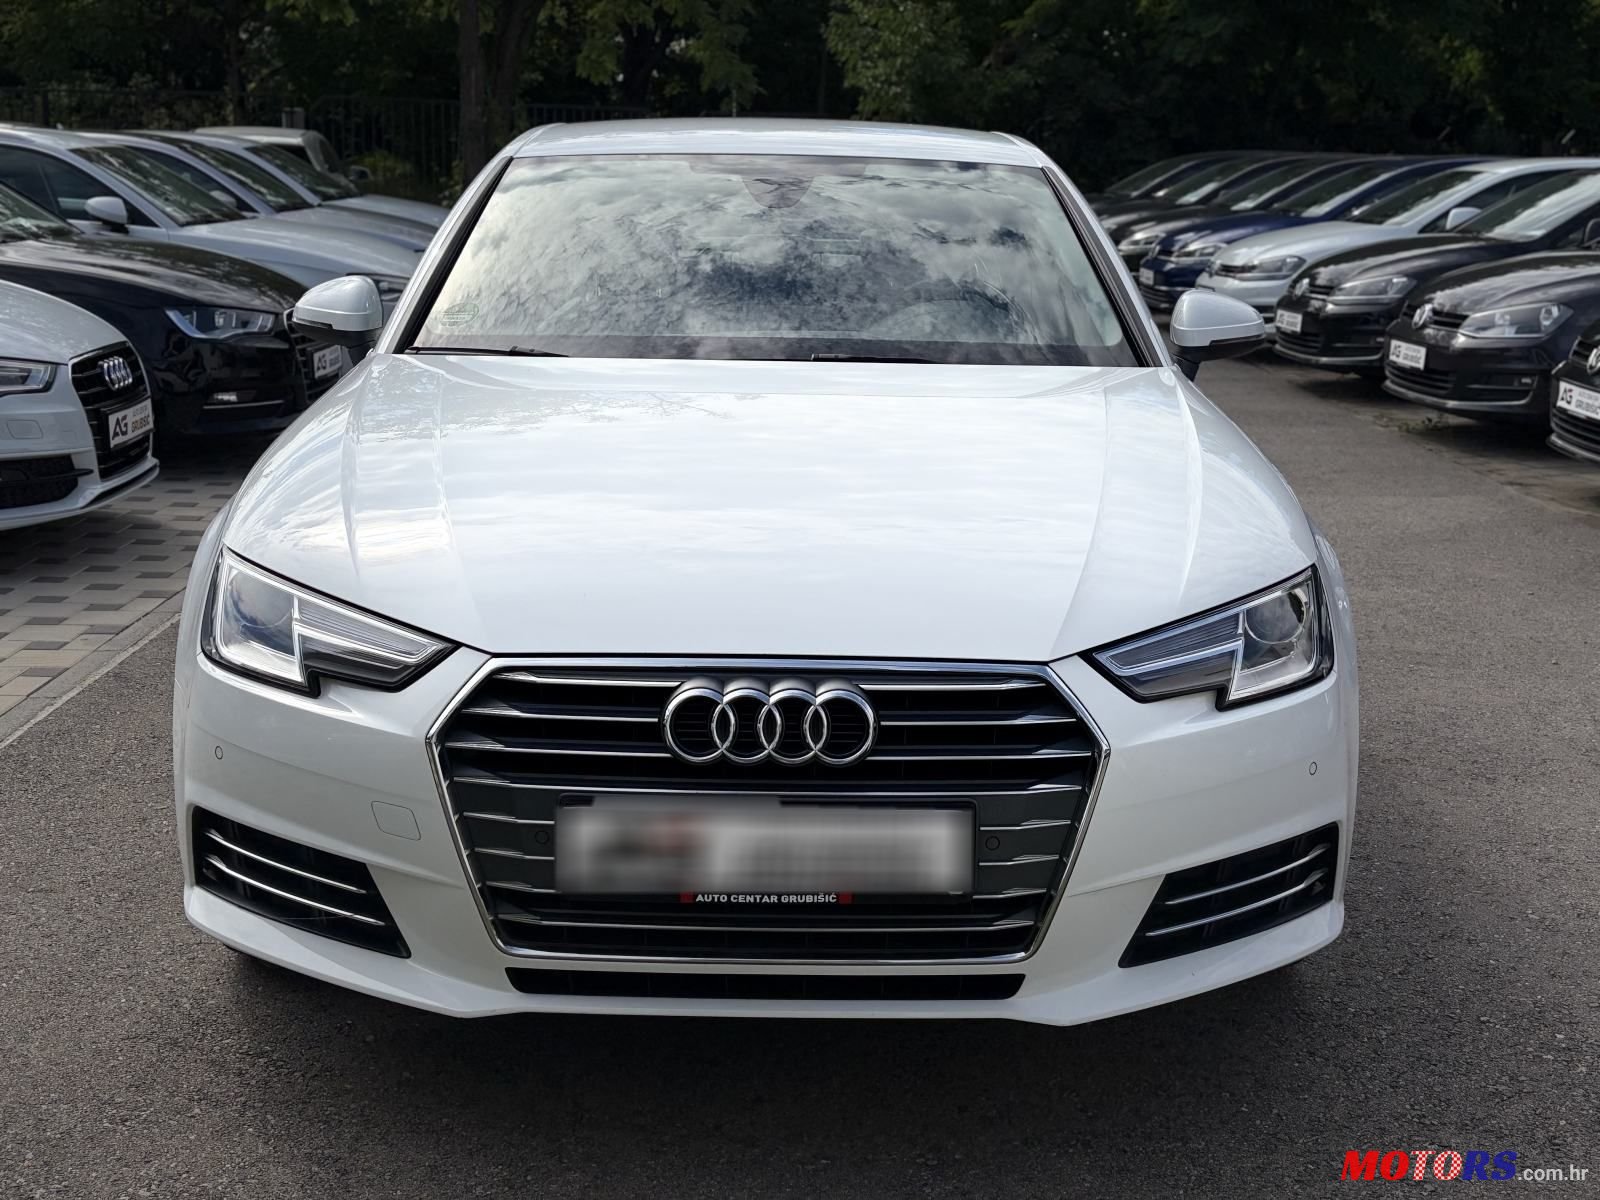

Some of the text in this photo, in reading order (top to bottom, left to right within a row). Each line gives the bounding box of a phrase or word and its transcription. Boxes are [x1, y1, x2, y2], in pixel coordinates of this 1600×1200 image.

[112, 414, 128, 441] AG
[696, 893, 838, 904] AUTO CENTAR GRUBIŠIĆ
